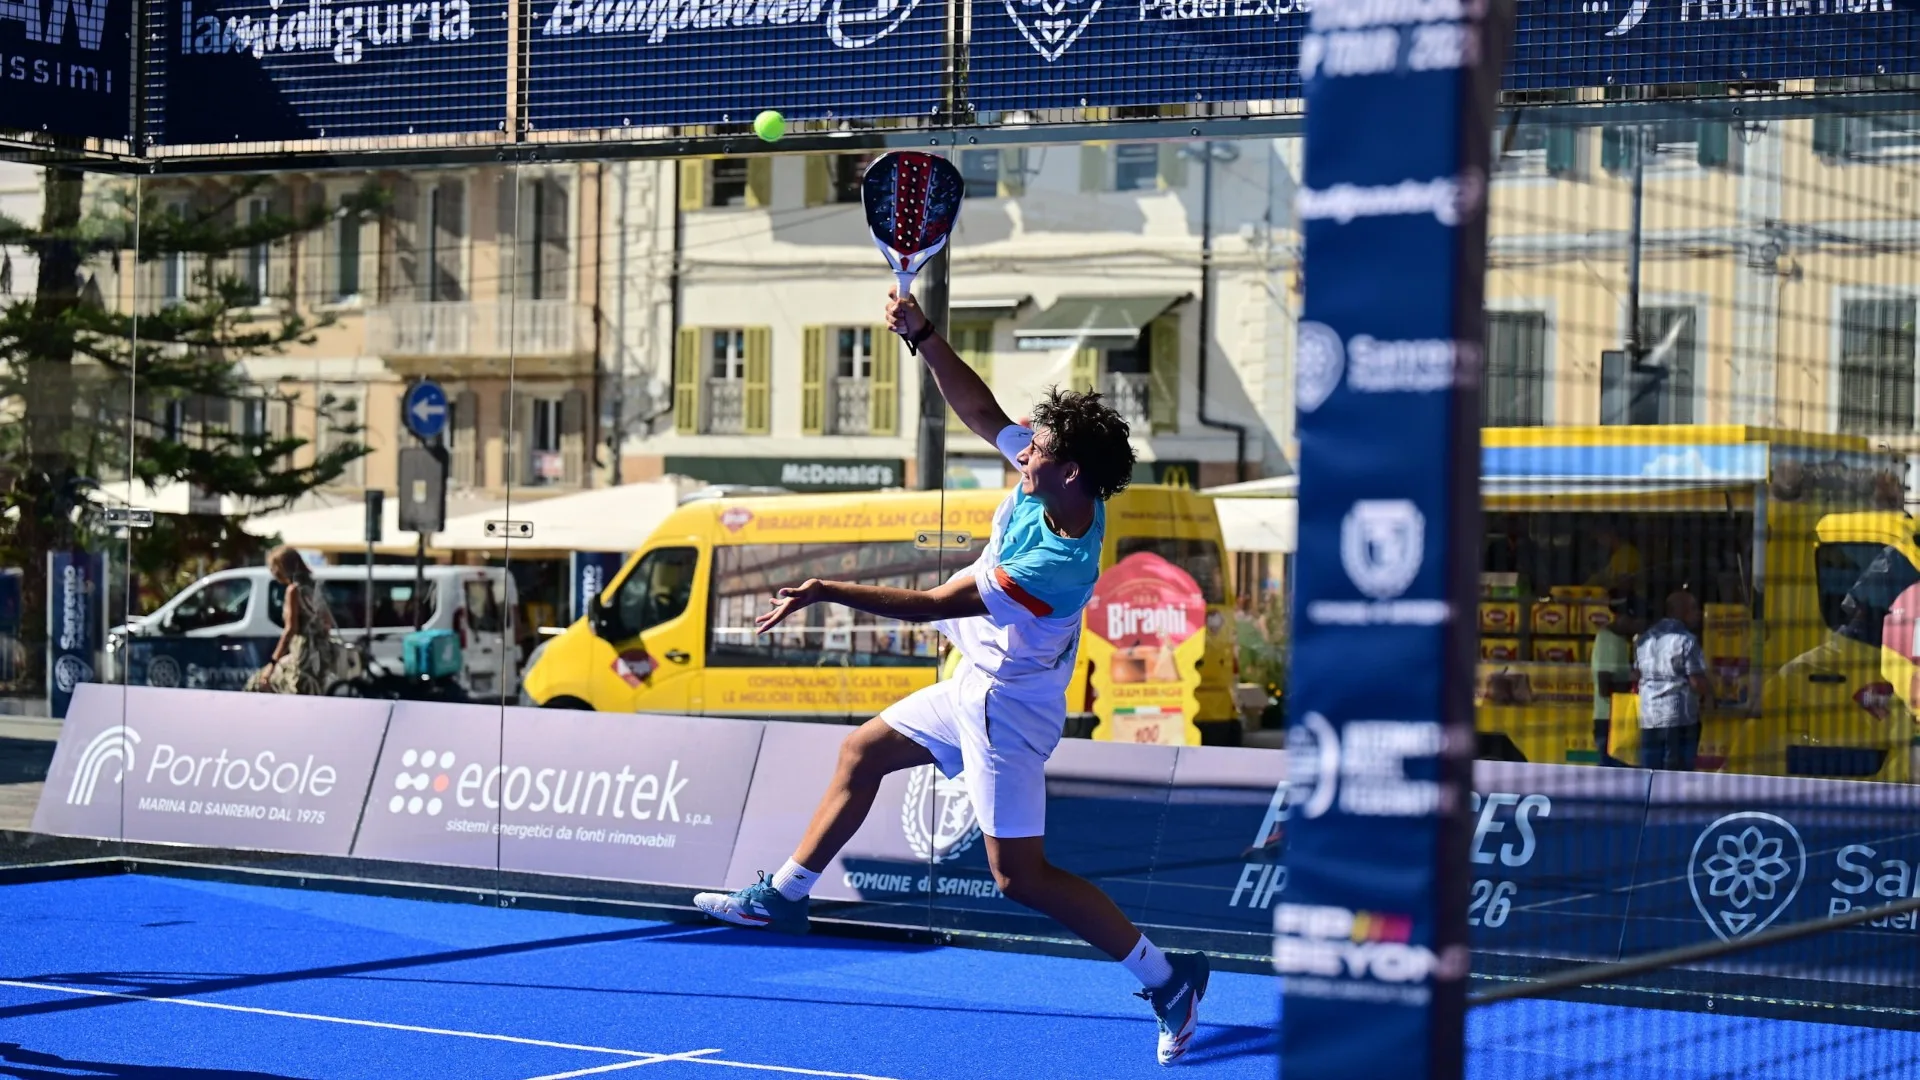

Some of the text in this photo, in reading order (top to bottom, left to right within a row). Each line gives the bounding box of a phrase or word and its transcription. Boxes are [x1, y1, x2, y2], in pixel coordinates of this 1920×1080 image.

[781, 463, 893, 485] McDonald's
[1107, 602, 1187, 640] Biraghi
[146, 744, 337, 797] PortoSole
[138, 797, 326, 825] MARINA DI SANREMO DAL 1975
[456, 759, 714, 826] ecosuntek s.p.a.
[445, 818, 677, 849] sistemi energetici da fonti rinnovabili
[1470, 791, 1551, 868] ES
[843, 871, 1005, 899] COMUNE di SANREM
[1229, 863, 1518, 929] FIP 26
